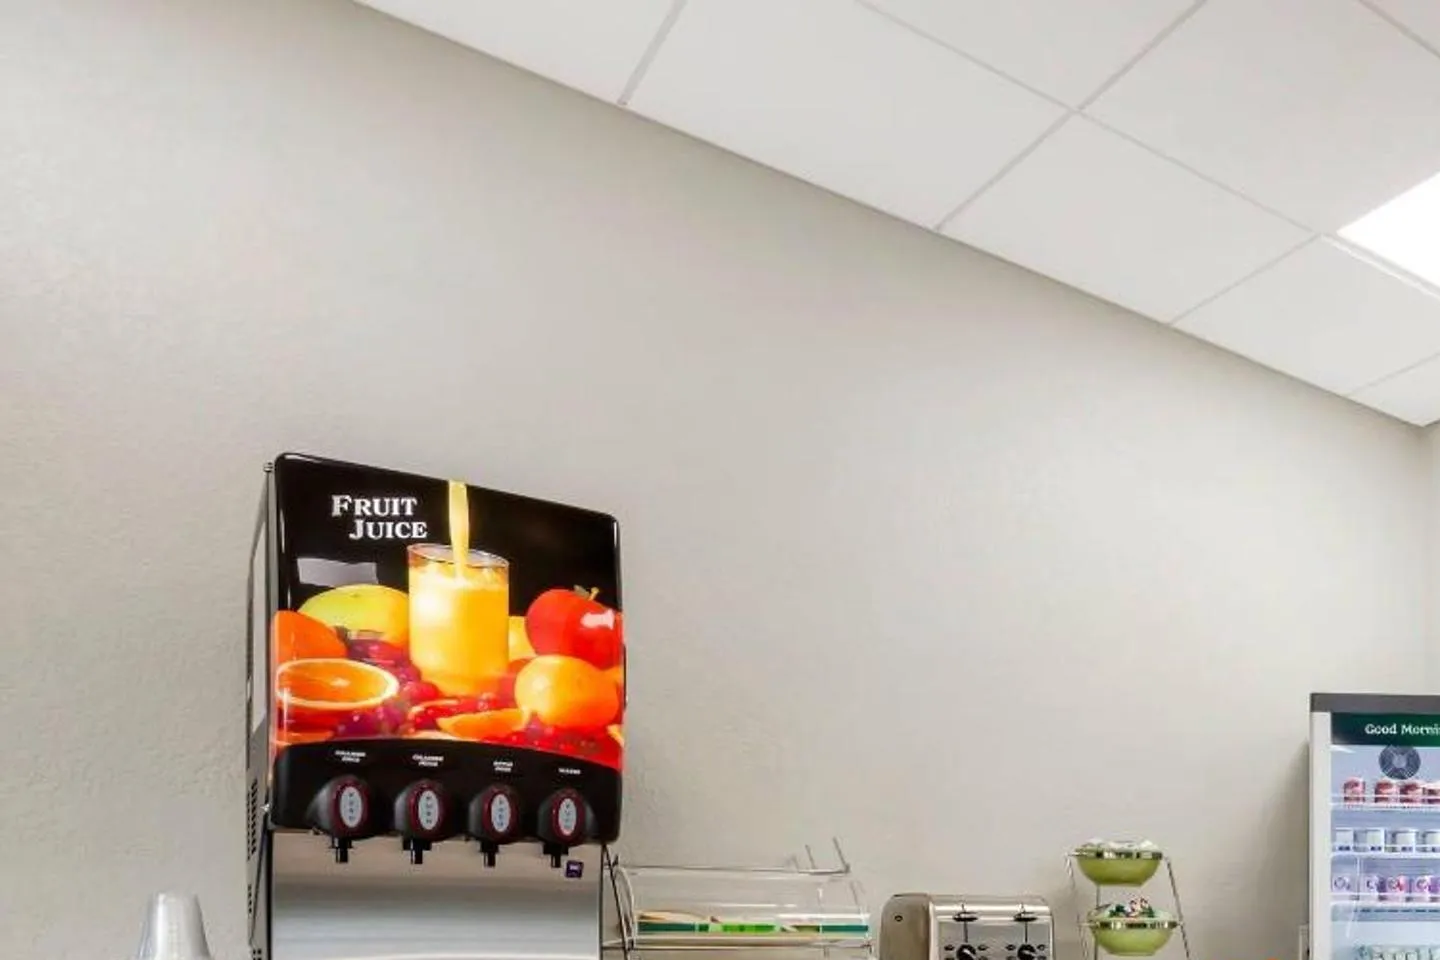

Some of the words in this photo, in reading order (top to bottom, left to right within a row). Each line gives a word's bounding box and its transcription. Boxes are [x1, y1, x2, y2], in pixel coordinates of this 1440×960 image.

[331, 494, 418, 518] FRUIT
[348, 519, 429, 540] JUICE
[1364, 722, 1398, 736] Good
